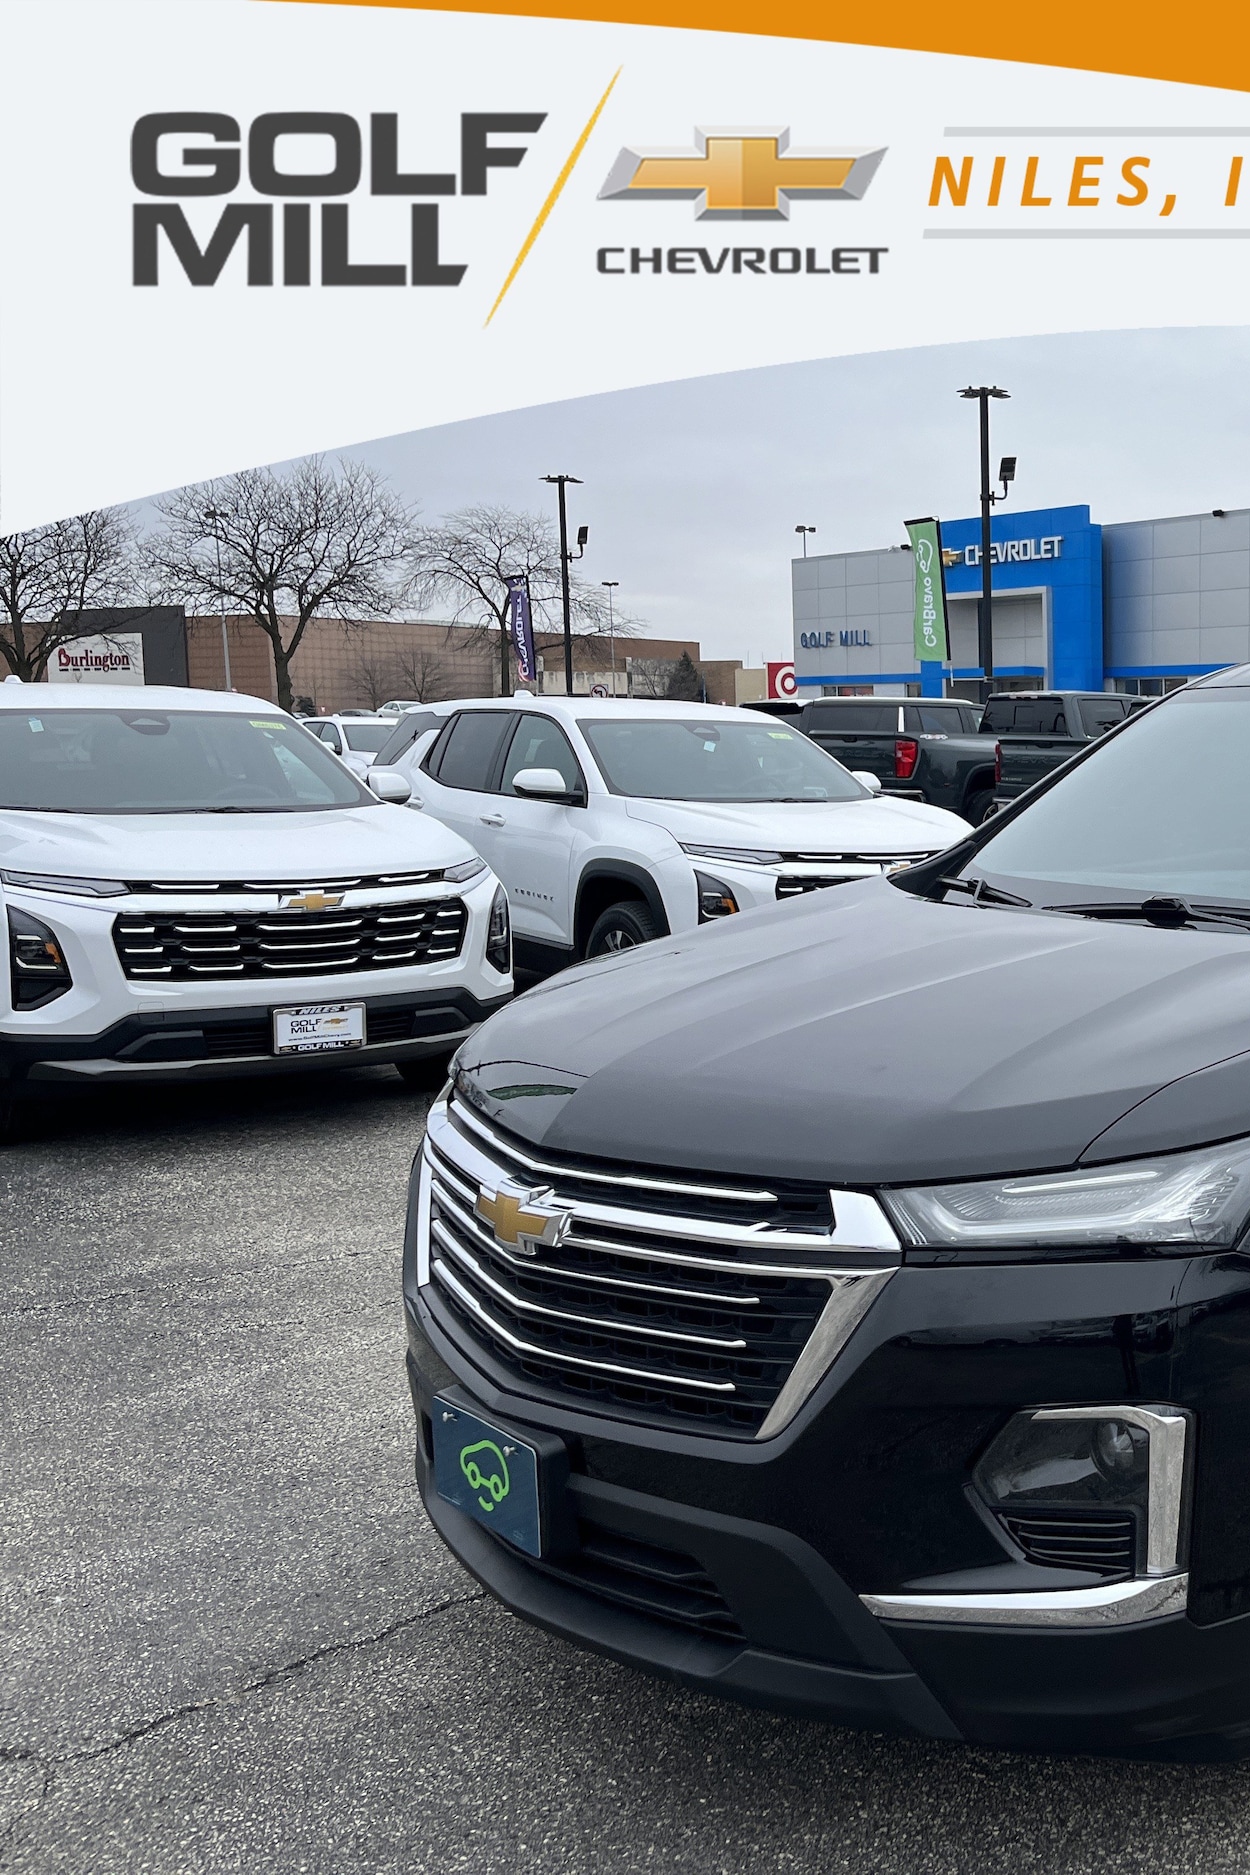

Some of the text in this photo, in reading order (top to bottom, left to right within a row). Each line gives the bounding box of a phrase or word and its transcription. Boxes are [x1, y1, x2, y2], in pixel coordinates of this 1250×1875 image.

[800, 629, 872, 649] GOLF MILL
[58, 647, 130, 672] Burlington
[299, 1006, 341, 1015] NILES
[290, 1018, 322, 1028] GOLF
[291, 1025, 317, 1034] MILL
[297, 1040, 344, 1051] GOLF MILL
